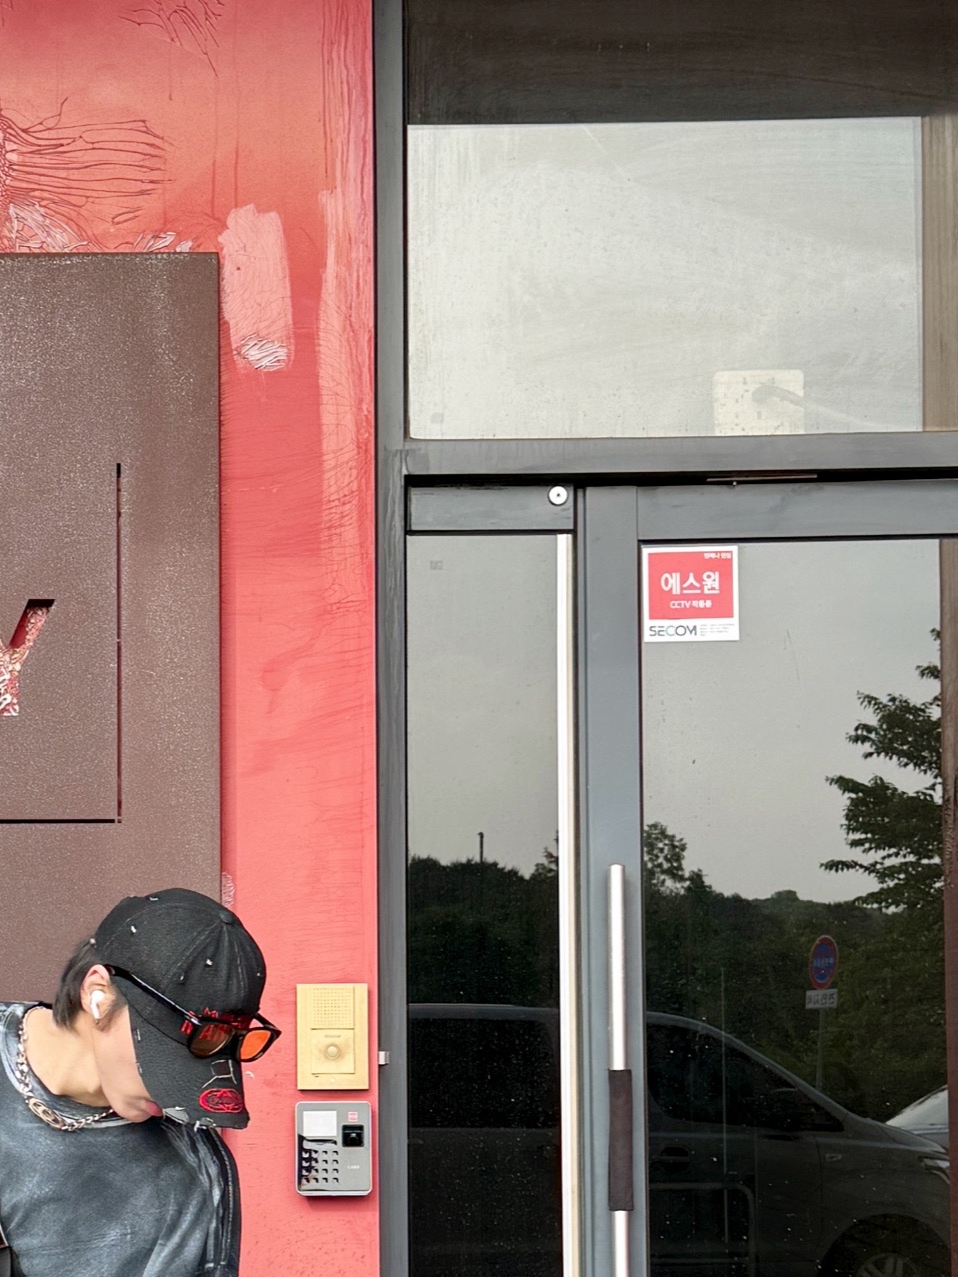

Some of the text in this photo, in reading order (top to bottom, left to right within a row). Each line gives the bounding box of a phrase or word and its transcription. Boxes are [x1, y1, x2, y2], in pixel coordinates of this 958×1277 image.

[660, 571, 720, 595] 에스원
[670, 600, 691, 609] CCTV
[649, 625, 697, 637] SECOM
